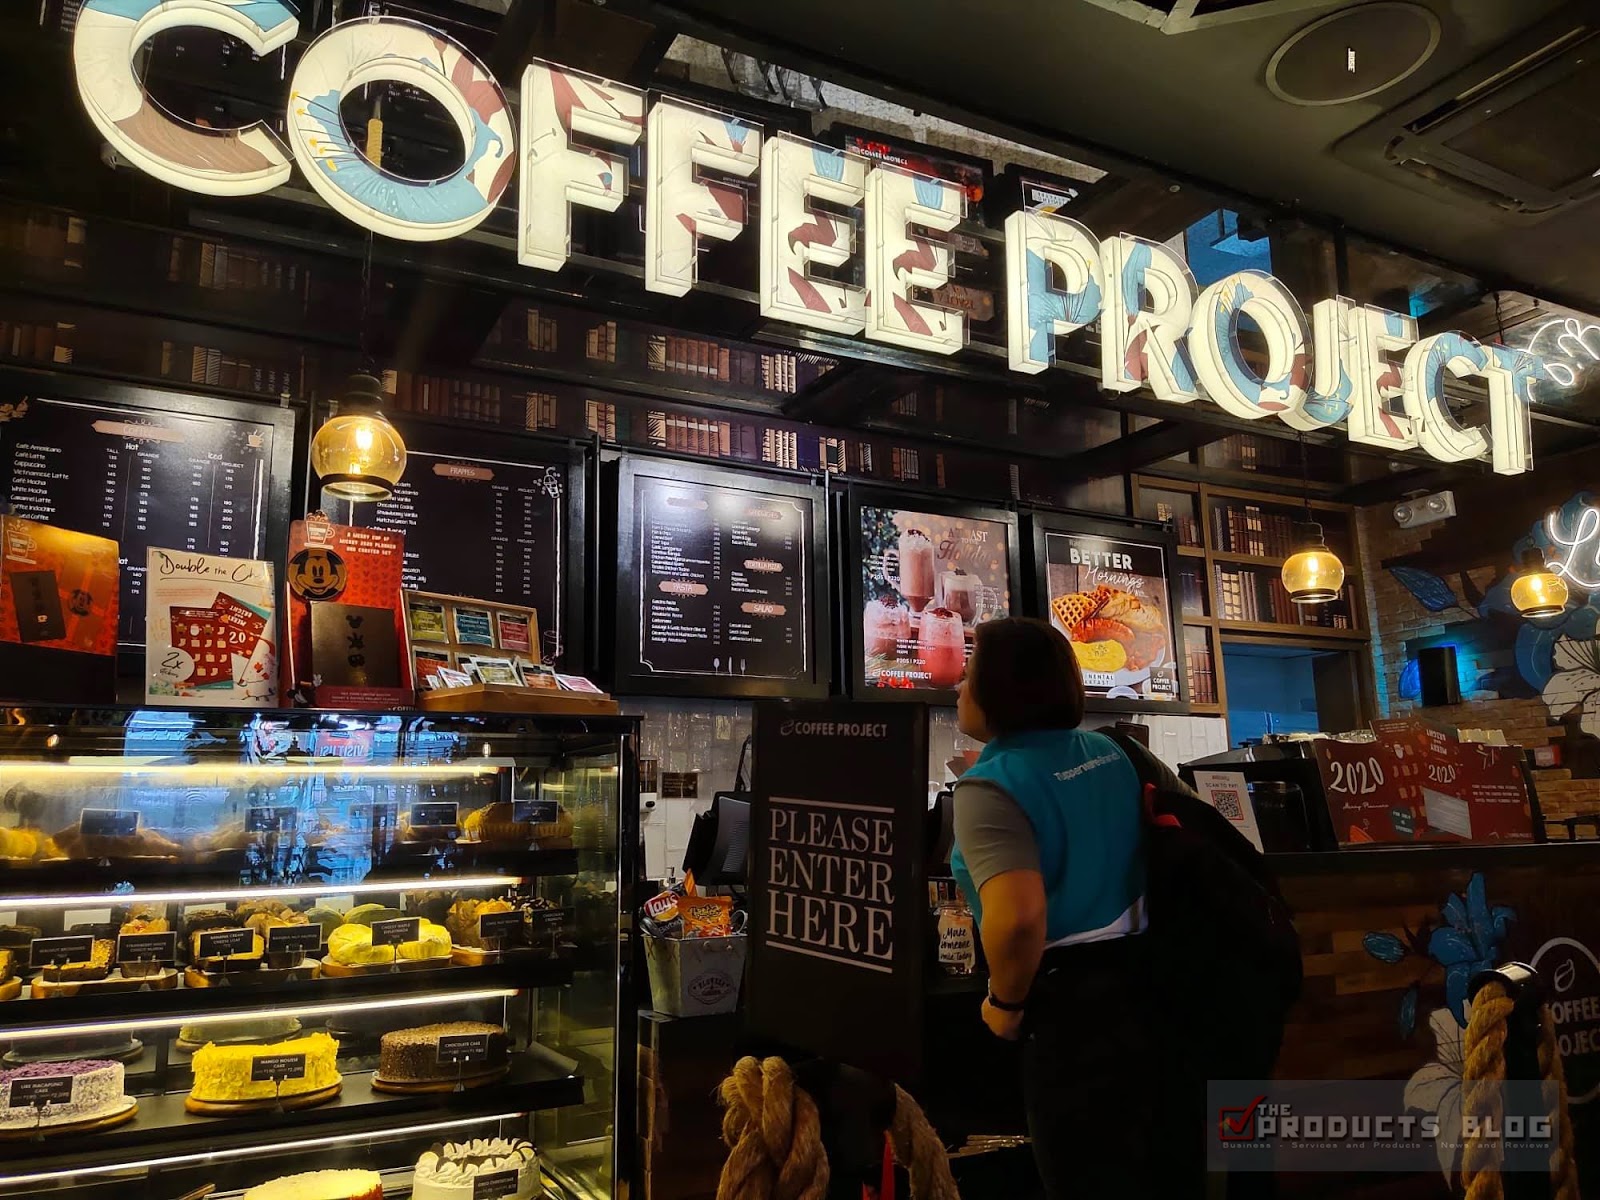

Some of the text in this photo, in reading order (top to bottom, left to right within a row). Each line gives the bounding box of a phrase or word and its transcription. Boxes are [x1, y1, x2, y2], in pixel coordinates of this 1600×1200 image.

[73, 0, 1540, 475] COFFEE PROJECT
[125, 443, 139, 451] Hot
[14, 460, 46, 469] Cappuccino
[13, 468, 69, 480] Vietnamese Latte
[160, 557, 210, 575] Double
[1069, 548, 1133, 571] BETTER
[673, 583, 693, 591] PASTA
[1085, 565, 1145, 594] Mornings
[753, 604, 773, 613] SALAD
[881, 669, 932, 680] COFFEE PROJECT
[1152, 684, 1172, 692] PROJECT
[795, 722, 887, 737] COFFEE PROJECT
[1328, 756, 1384, 795] 2020
[1428, 764, 1456, 784] 2020
[768, 808, 893, 856] PLEASE
[768, 846, 895, 905] ENTER
[766, 889, 893, 960] HERE
[943, 928, 968, 940] Make
[1545, 996, 1600, 1024] OFFEE
